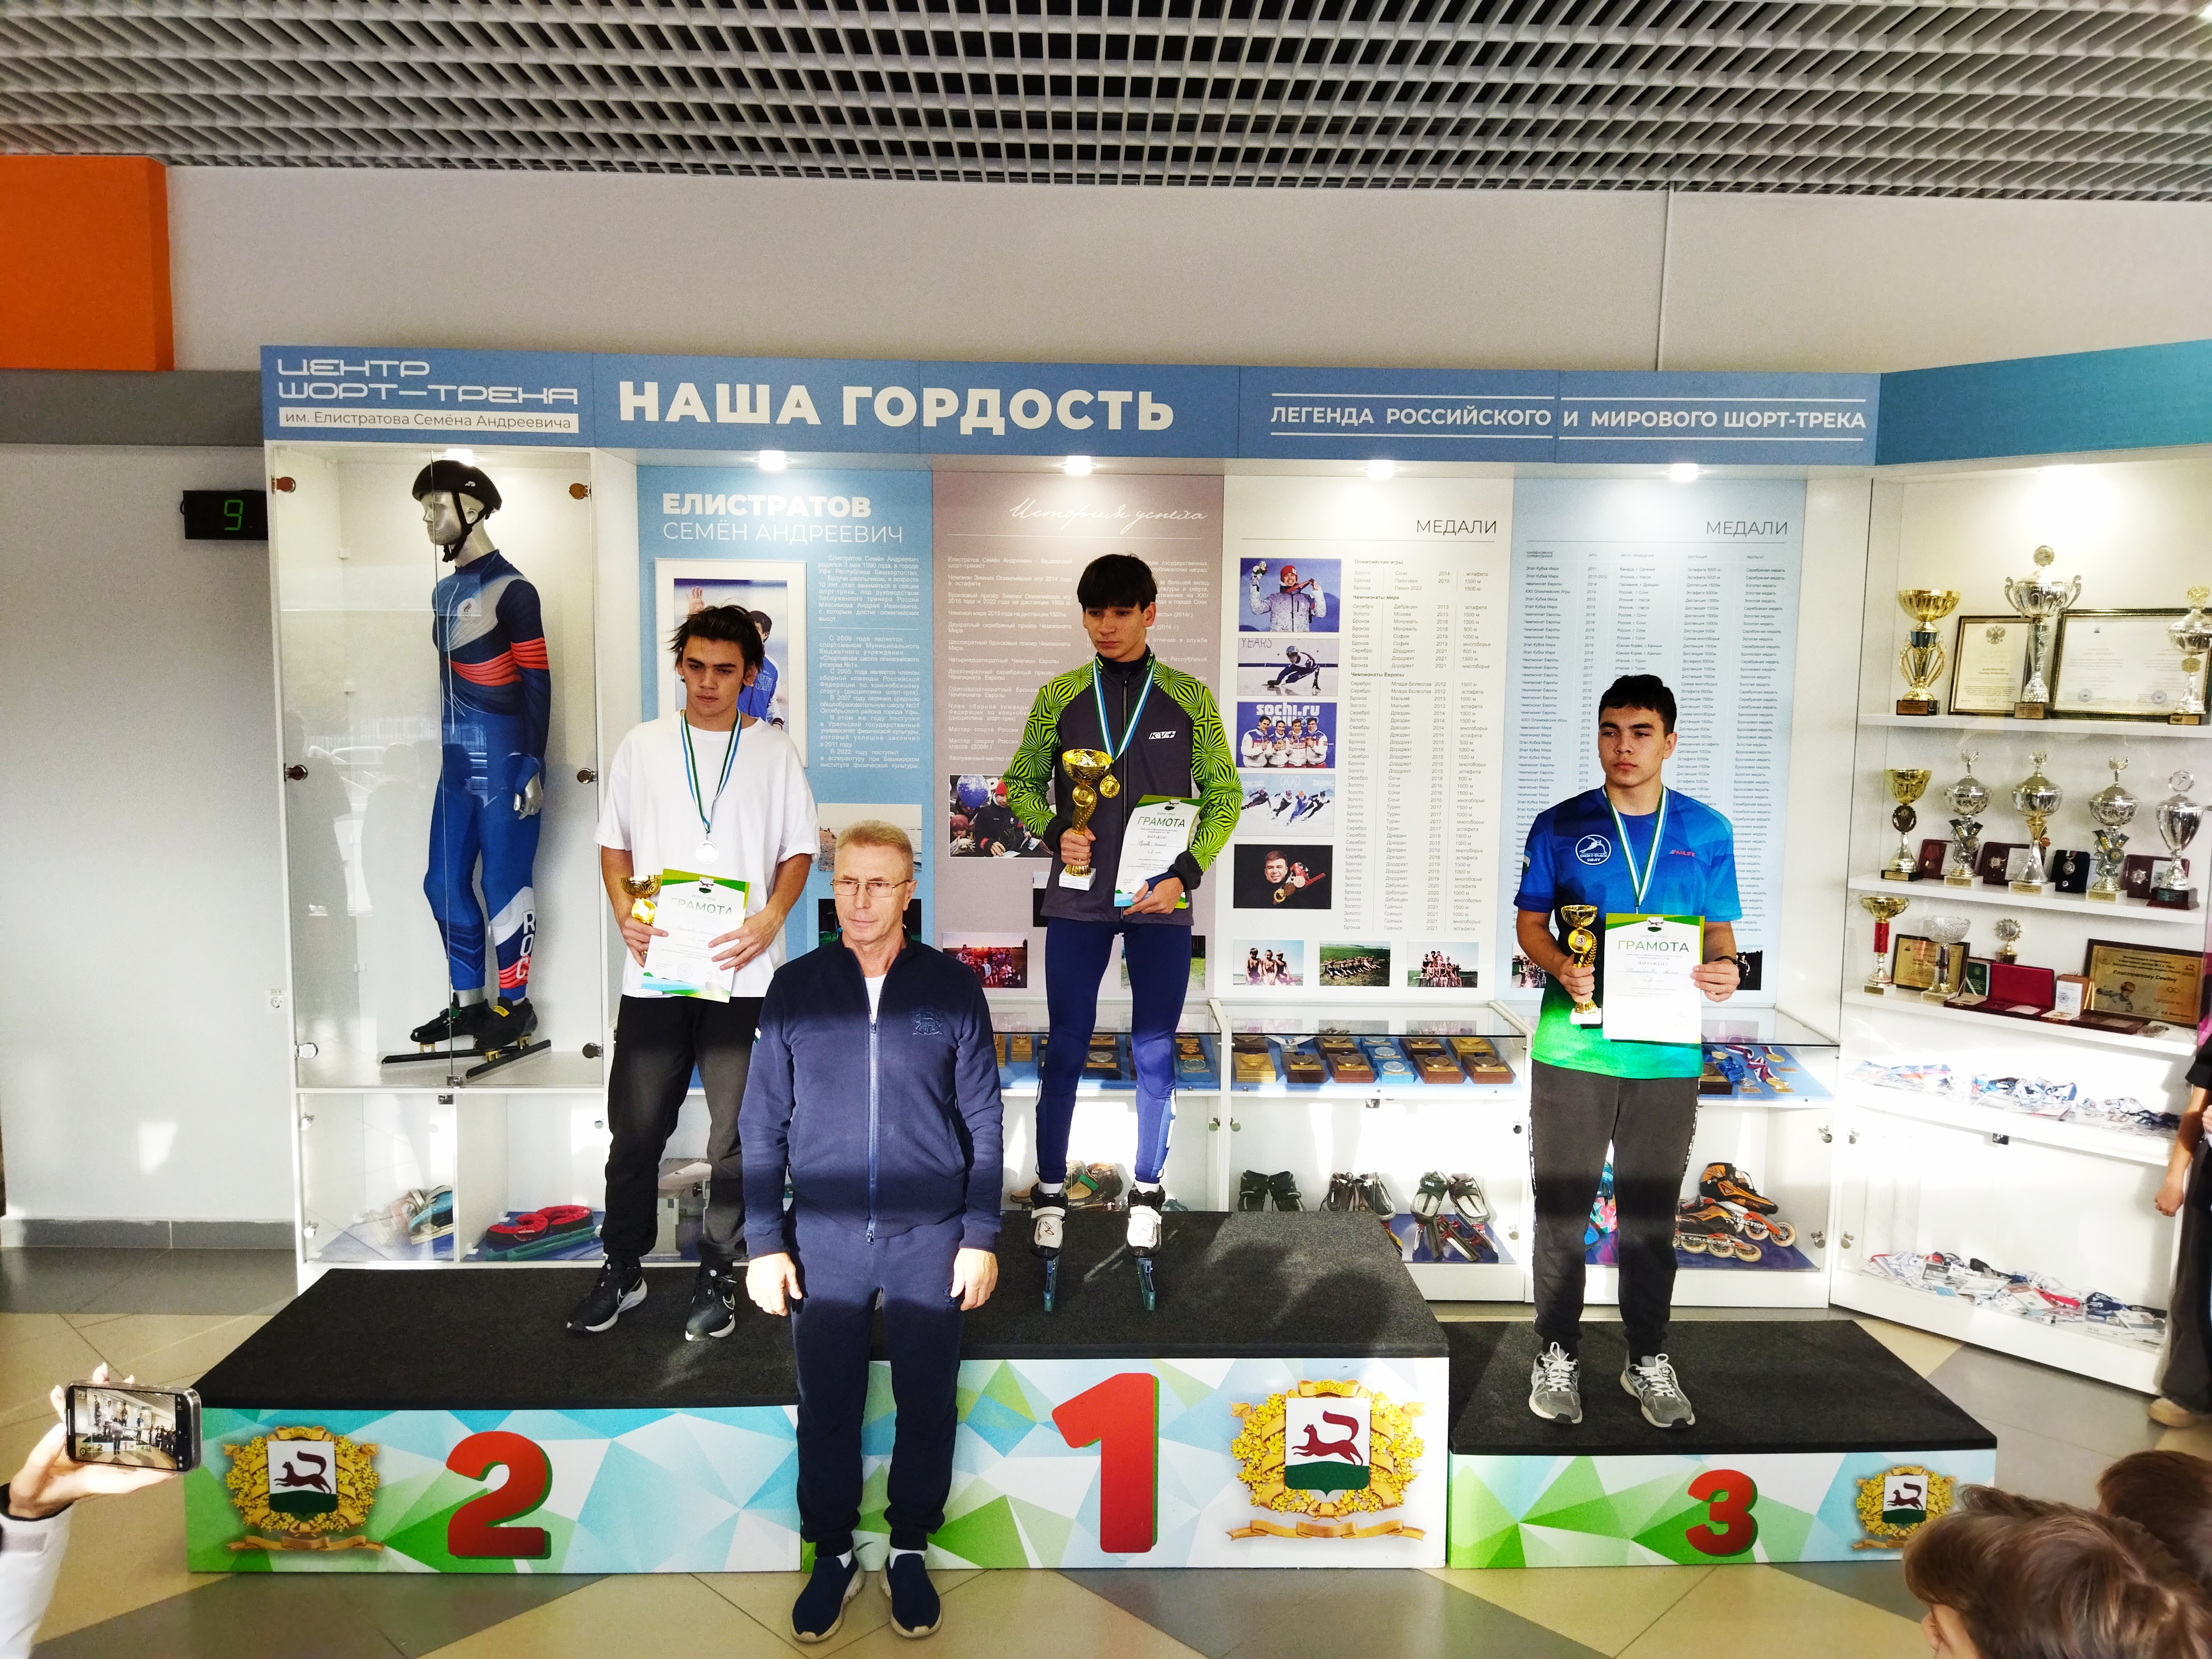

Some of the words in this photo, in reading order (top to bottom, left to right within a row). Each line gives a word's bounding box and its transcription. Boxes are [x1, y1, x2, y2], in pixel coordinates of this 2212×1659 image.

[278, 359, 430, 377] ЦЕНТР
[619, 381, 822, 426] НАША
[843, 385, 1173, 436] ГОРДОСТЬ
[1270, 406, 1374, 426] ЛЕГЕНДА
[1386, 403, 1552, 427] РОССИЙСКОГО
[1563, 411, 1577, 427] И
[1592, 410, 1718, 430] МИРОВОГО
[1724, 411, 1866, 430] ШОРТ-ТРЕКА
[285, 413, 310, 424] им.
[315, 411, 409, 427] Елистратова
[414, 413, 472, 426] Семёна
[476, 414, 571, 430] Андреевича
[223, 499, 243, 531] 9
[662, 493, 871, 518] ЕЛИСТРАТОВ
[1009, 497, 1130, 530] История
[1119, 511, 1207, 535] успеха
[663, 519, 747, 542] СЕМЁН
[756, 524, 902, 545] АНДРЕЕВИЧ
[1416, 520, 1497, 535] МЕДАЛИ
[1707, 520, 1788, 536] МЕДАЛИ
[1241, 638, 1272, 648] YEARS
[1256, 702, 1320, 716] sochi.ru
[1149, 731, 1176, 739] KV+
[1138, 816, 1185, 827] ГРАМОТА
[671, 897, 732, 915] ГРАМОТА
[516, 910, 535, 979] ROC
[1618, 940, 1689, 952] ГРАМОТА
[1052, 1371, 1160, 1554] 1
[446, 1431, 552, 1559] 2
[1686, 1469, 1757, 1557] 3
